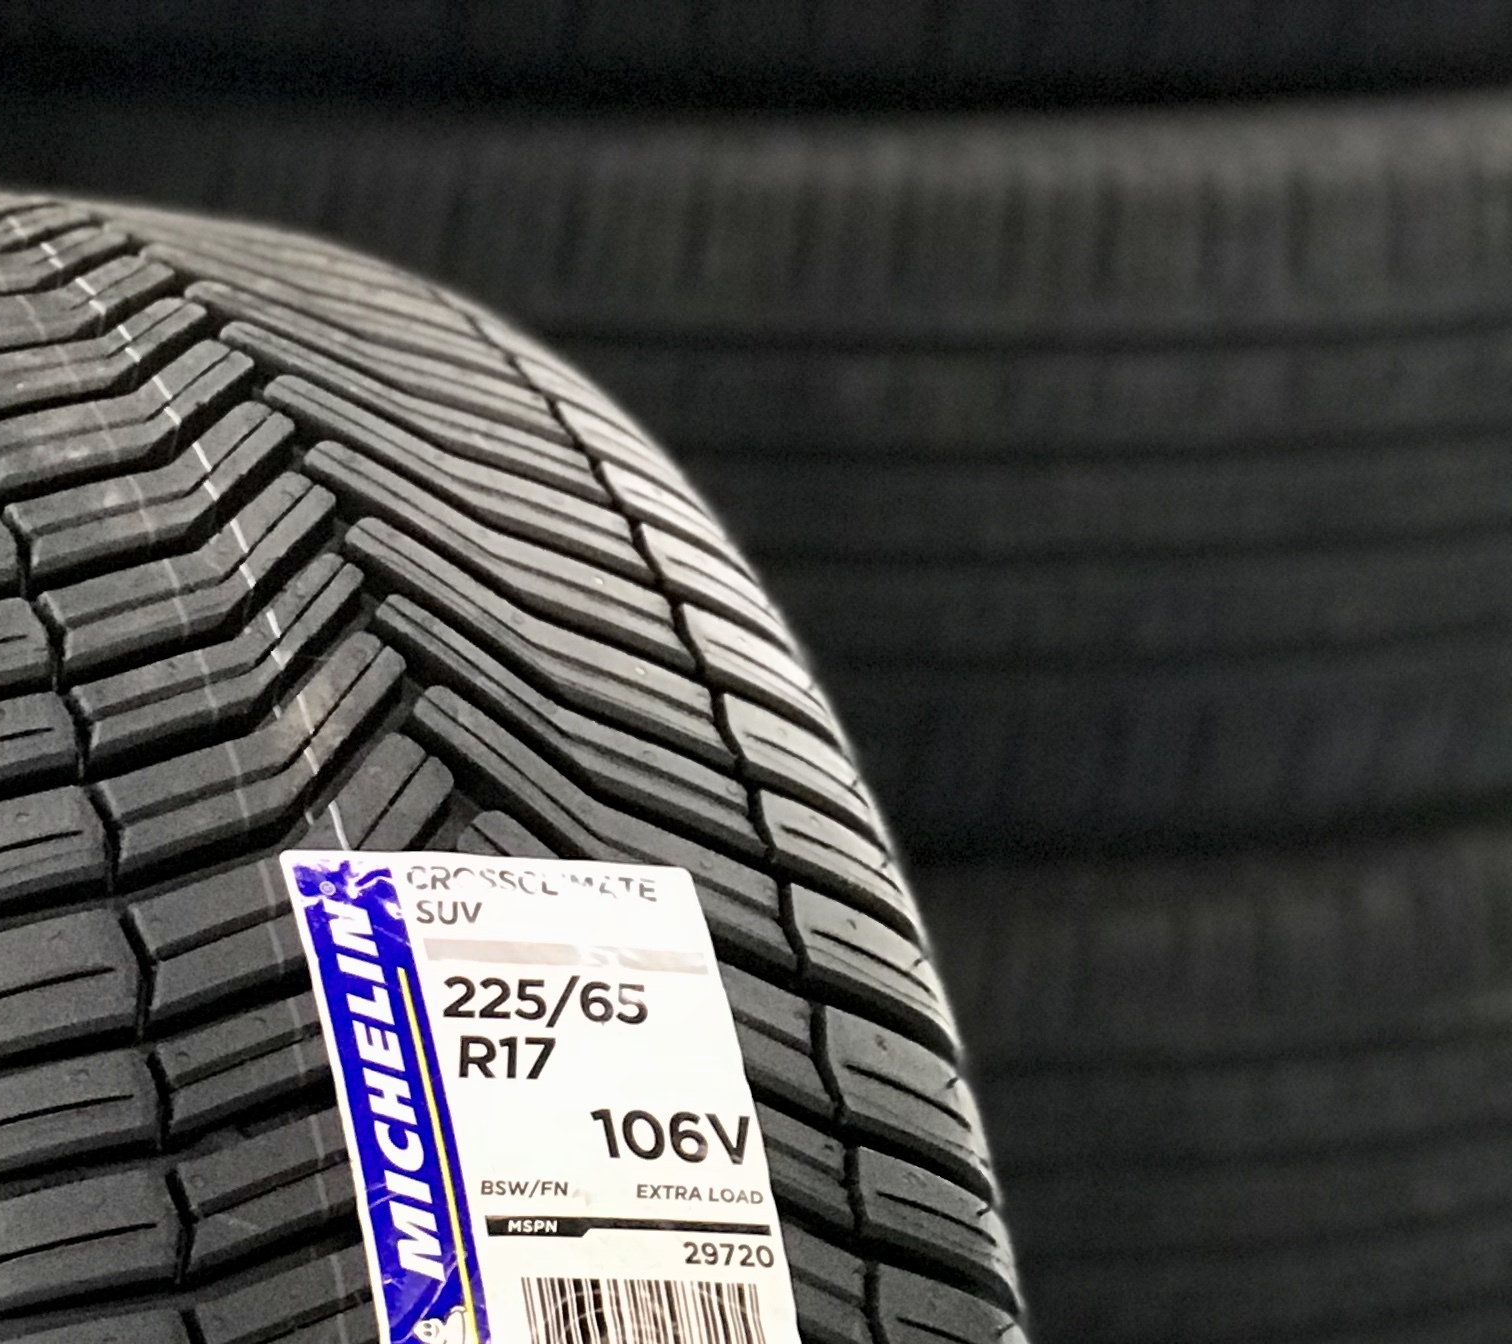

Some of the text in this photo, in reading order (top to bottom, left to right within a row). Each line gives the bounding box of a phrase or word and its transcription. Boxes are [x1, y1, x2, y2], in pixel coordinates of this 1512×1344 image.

[406, 865, 658, 902] CROSSCLMATE
[417, 900, 482, 925] SUV
[443, 975, 648, 1028] 225/65
[459, 1035, 556, 1080] R17
[324, 898, 448, 1282] MICHELIN
[589, 1108, 750, 1166] 106V
[481, 1180, 568, 1198] BSW/FN
[637, 1184, 764, 1205] EXTRA LOAD
[507, 1218, 558, 1233] MSPN
[683, 1242, 774, 1268] 29720
